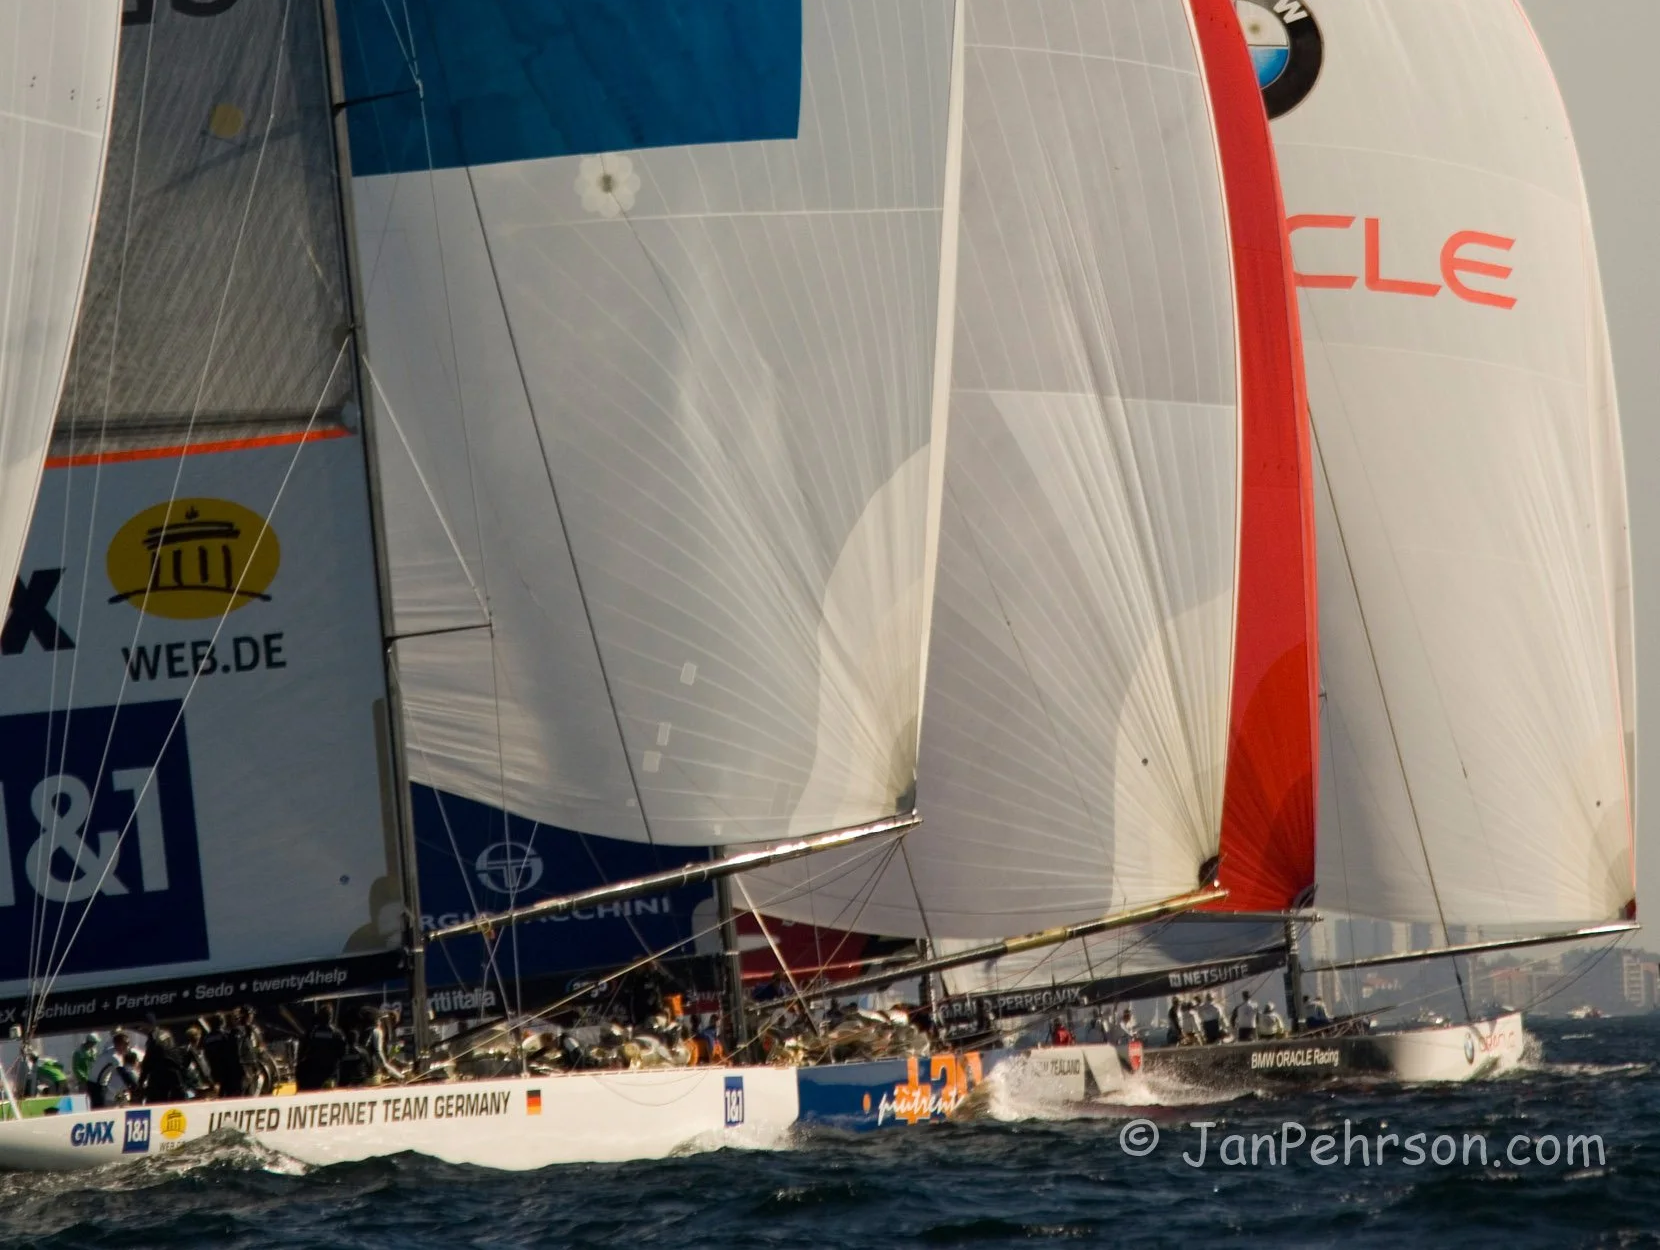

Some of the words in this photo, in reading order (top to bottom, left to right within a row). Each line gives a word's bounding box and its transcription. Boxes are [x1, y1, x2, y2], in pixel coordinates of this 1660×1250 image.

[122, 632, 287, 682] WEB.DE
[1183, 964, 1249, 986] NETSUITE
[37, 999, 97, 1021] Schlund
[115, 991, 177, 1010] Partner
[195, 982, 234, 1000] Sedo
[252, 967, 347, 992] twenty4help
[1251, 1052, 1275, 1069] BMW
[1276, 1049, 1313, 1067] ORACLE
[1314, 1047, 1340, 1067] Racing
[286, 1101, 377, 1130] INTERNET
[383, 1096, 428, 1123] TEAM
[434, 1090, 511, 1119] GERMANY
[725, 1089, 744, 1124] 1&1
[71, 1121, 114, 1146] GMX
[126, 1118, 149, 1143] 1&1
